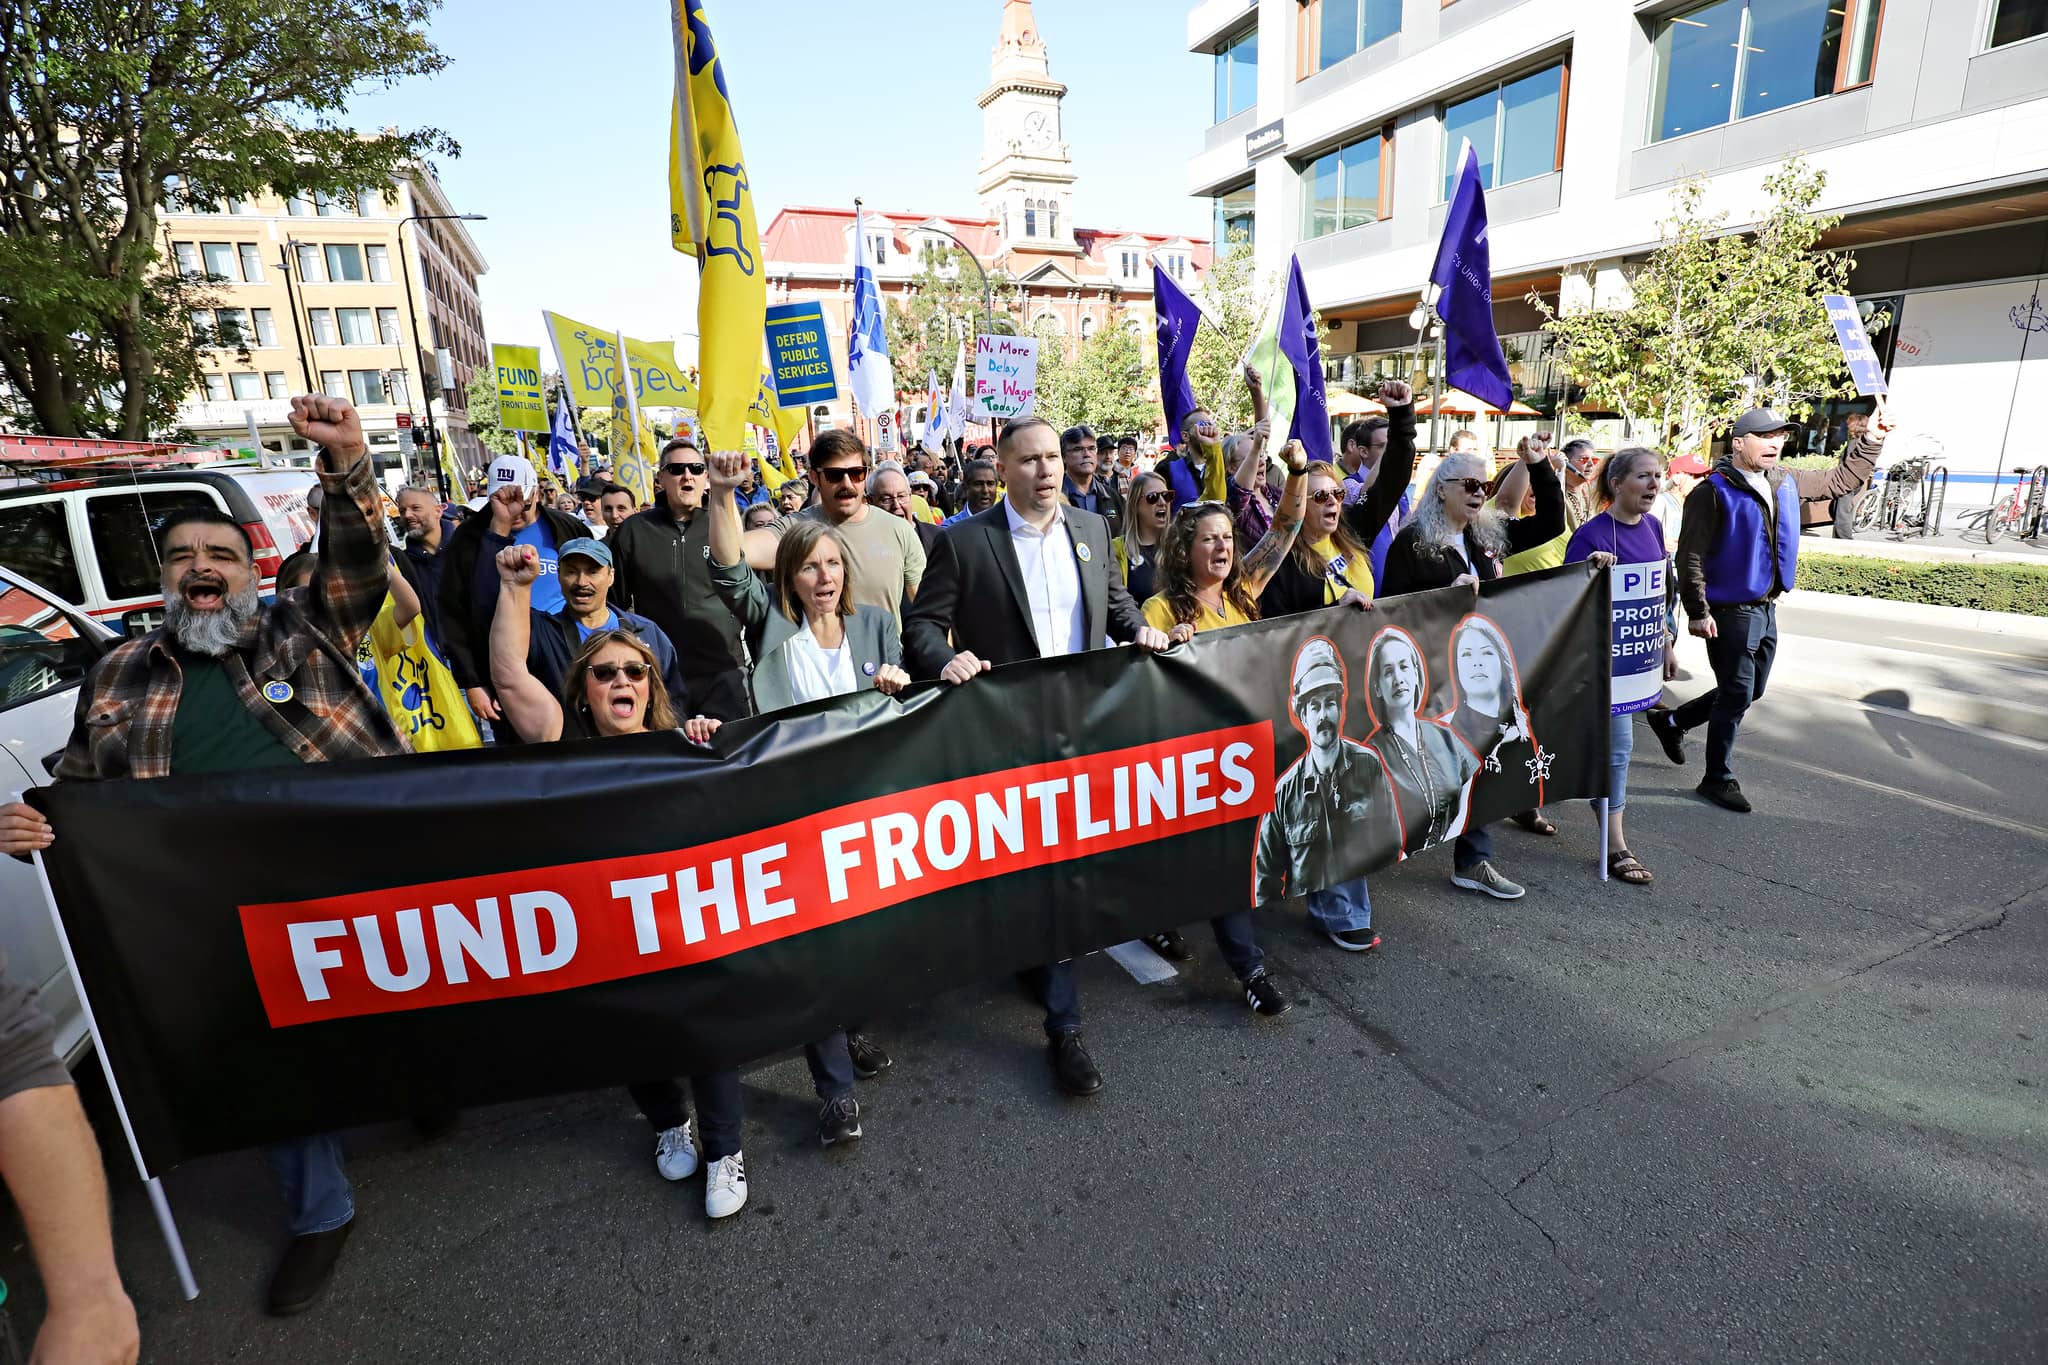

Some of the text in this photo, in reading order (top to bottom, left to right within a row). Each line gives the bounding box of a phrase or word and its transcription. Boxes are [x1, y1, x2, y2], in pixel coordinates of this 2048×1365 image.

[1461, 265, 1483, 292] Union
[776, 331, 818, 348] DEFEND
[1000, 341, 1030, 357] More
[781, 347, 819, 363] PUBLIC
[498, 367, 538, 387] FUND
[778, 362, 829, 379] SERVICES
[989, 358, 1020, 377] Delay
[515, 390, 527, 398] THE
[977, 380, 1033, 402] Fair Wage
[502, 400, 542, 411] FRONTLINES
[981, 396, 1026, 417] Today!
[1612, 603, 1665, 623] PROTE
[1620, 618, 1665, 639] PUBLI
[1612, 635, 1665, 657] SERVIC
[1622, 703, 1641, 712] Union
[287, 743, 1256, 1002] FUND THE FRONTLINES
